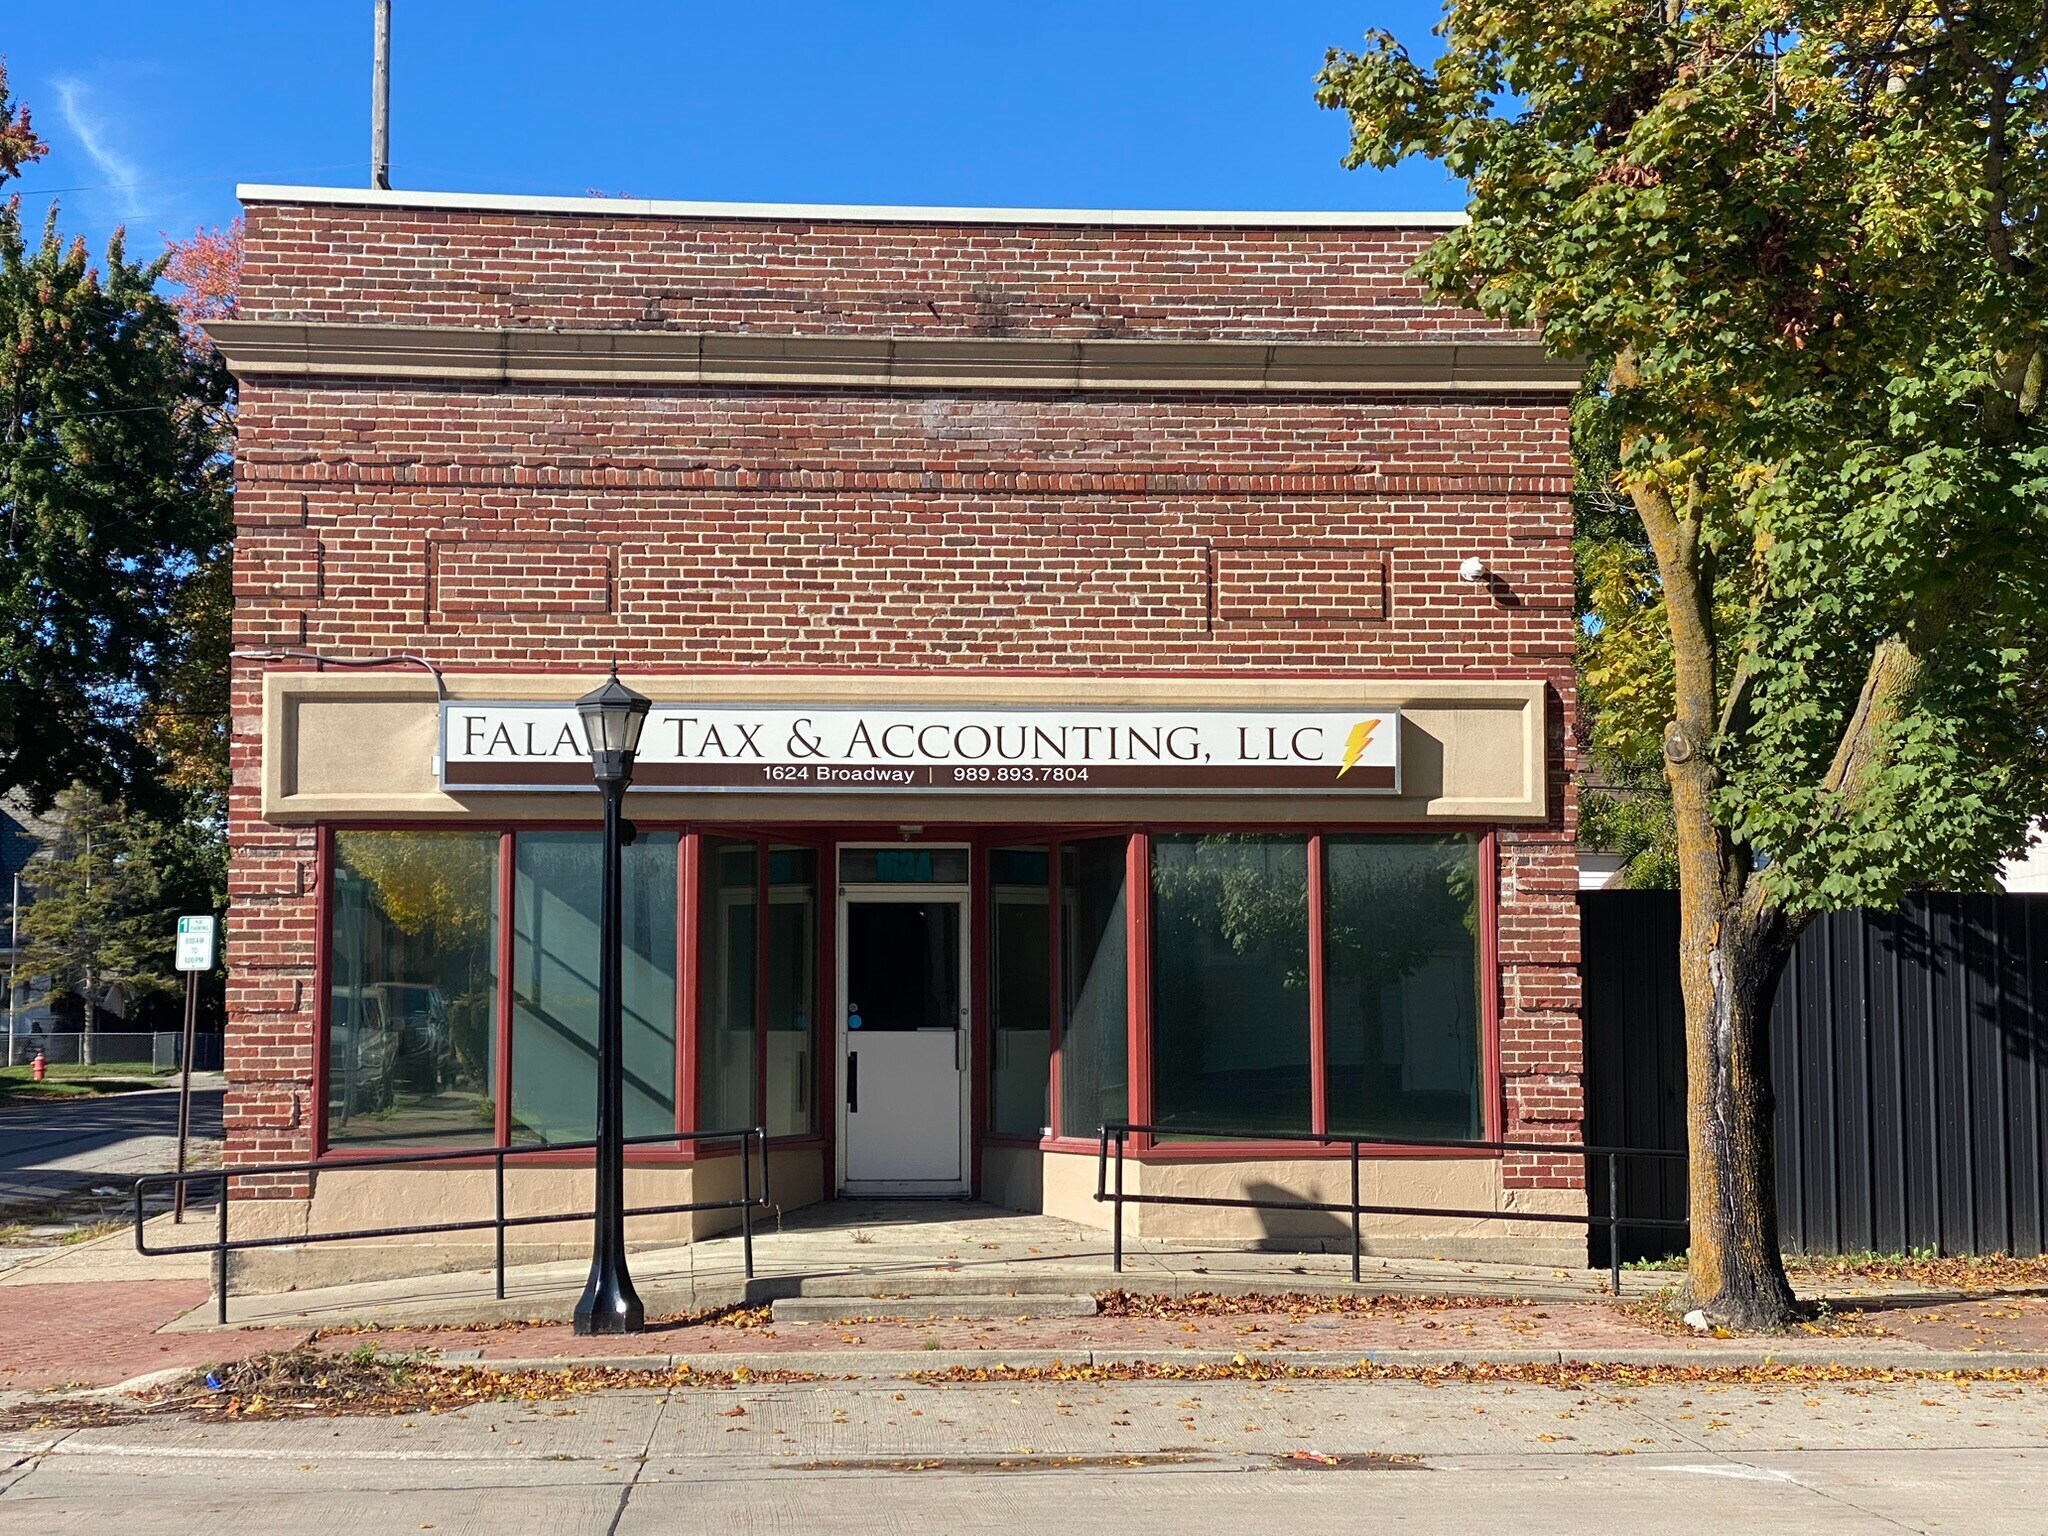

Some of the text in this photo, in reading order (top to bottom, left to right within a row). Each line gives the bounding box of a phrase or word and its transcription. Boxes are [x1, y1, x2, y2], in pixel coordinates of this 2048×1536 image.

[462, 715, 1325, 763] FALA TAX & ACCOUNTING, LLC
[761, 765, 1089, 784] 1624 Broadway 989.893.7804
[875, 852, 933, 881] 1624
